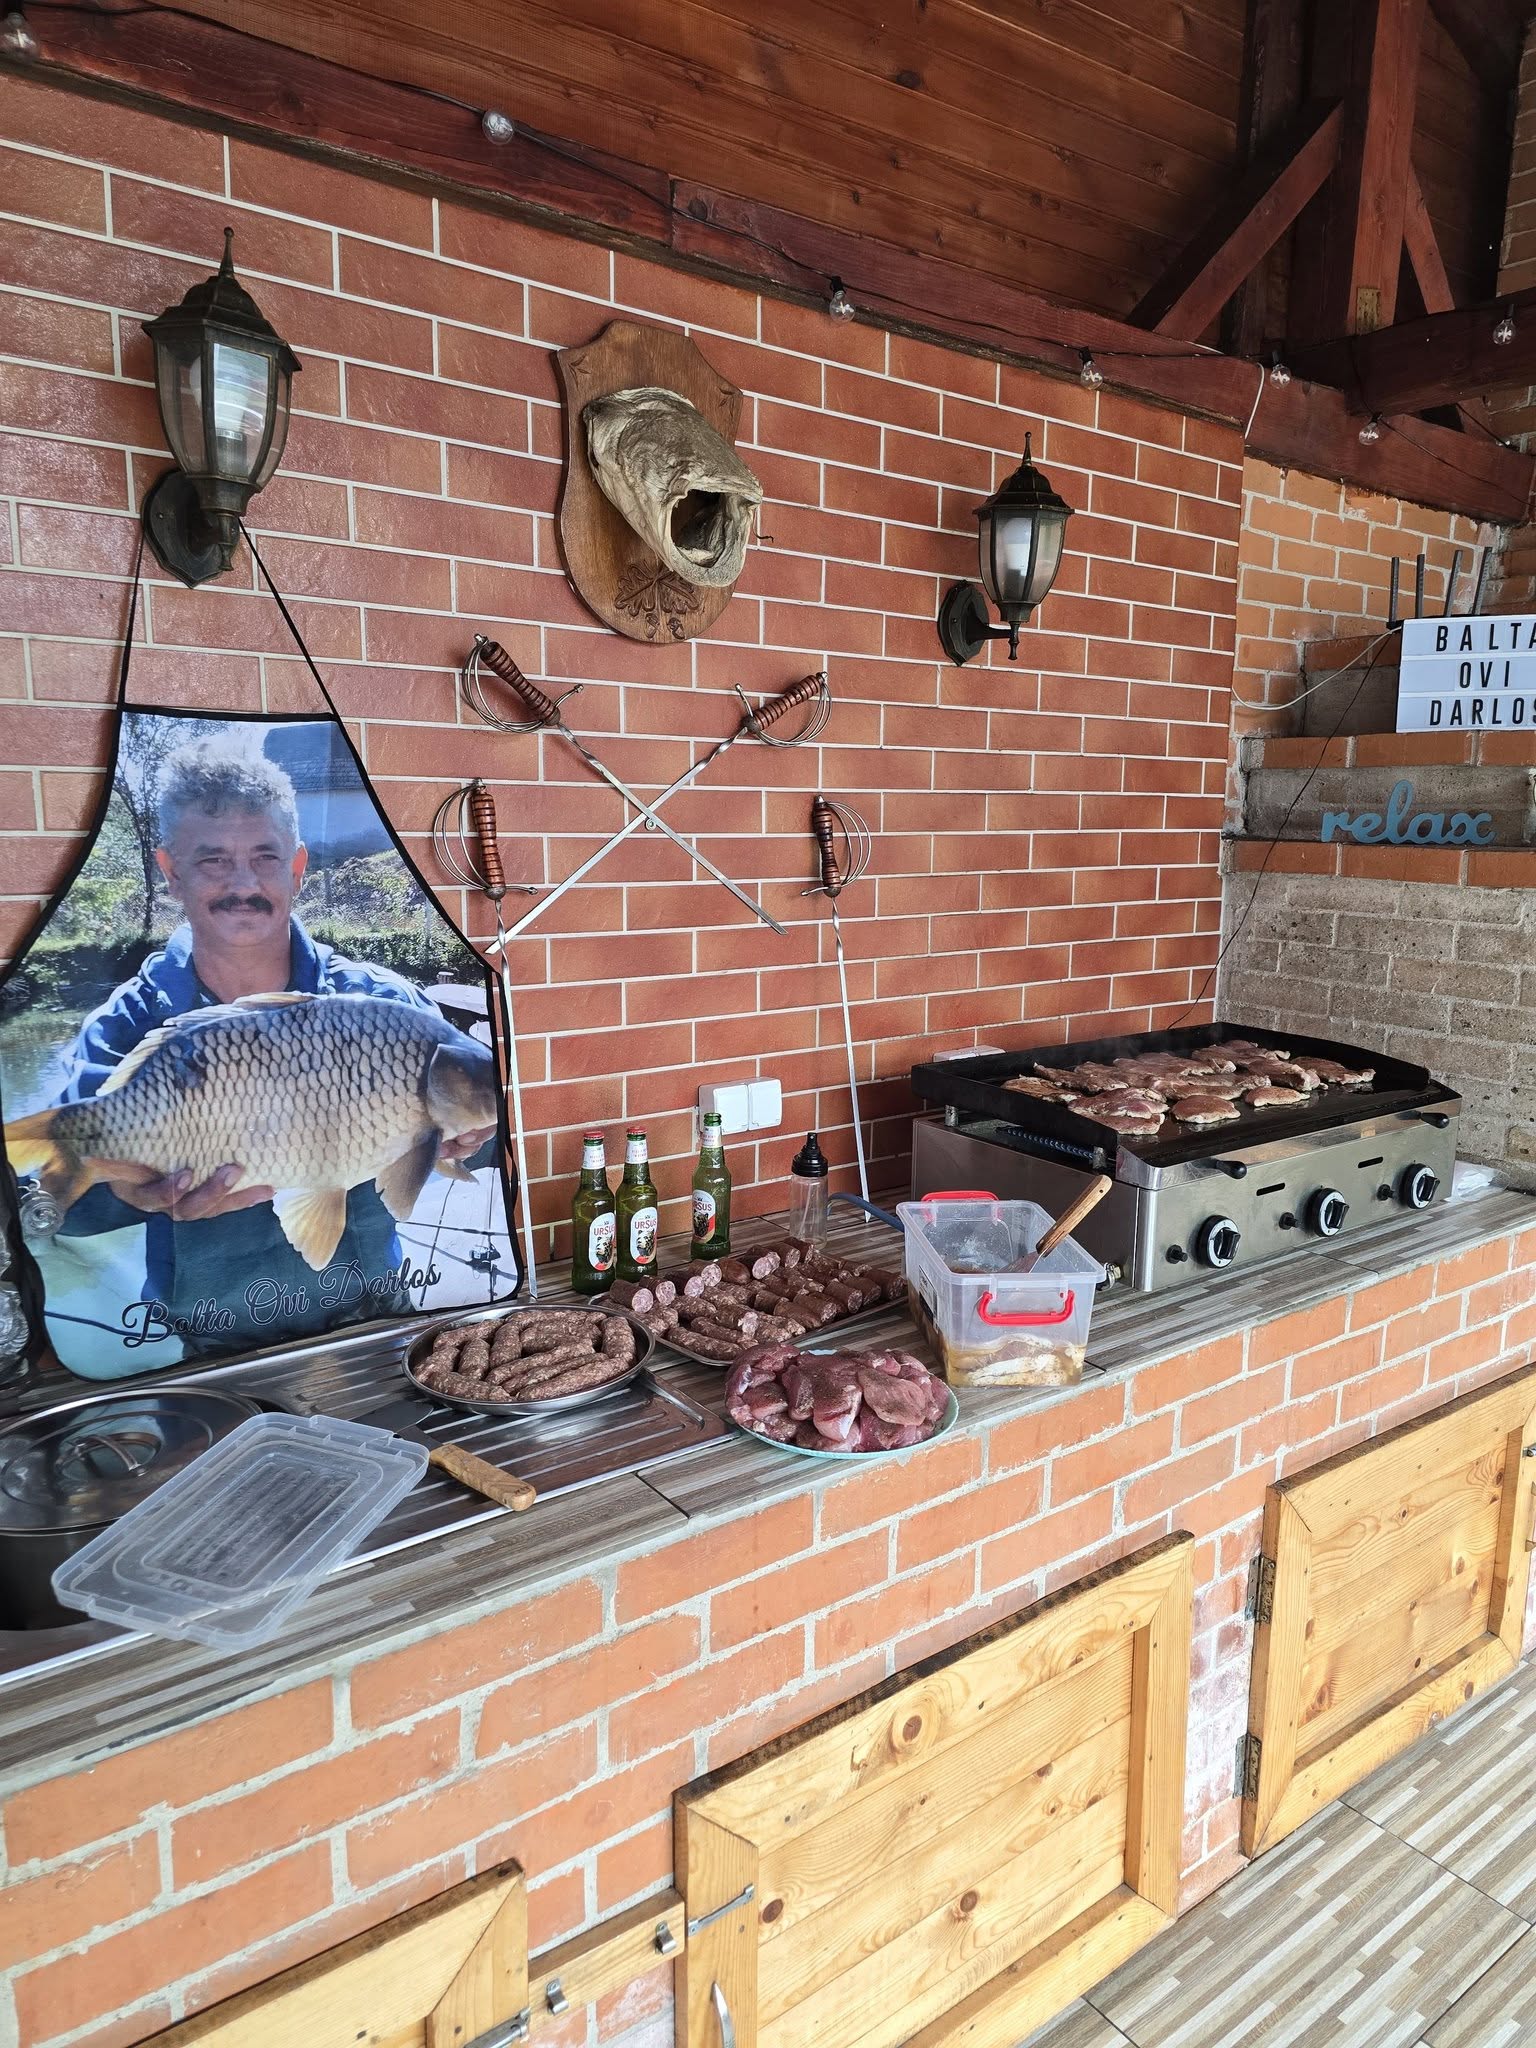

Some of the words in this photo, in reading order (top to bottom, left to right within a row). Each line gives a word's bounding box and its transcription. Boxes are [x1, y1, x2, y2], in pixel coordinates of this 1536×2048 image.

[1436, 622, 1536, 652] BALTA
[1460, 661, 1510, 688] OVI
[1321, 779, 1496, 845] relax
[122, 1297, 237, 1348] Balta
[244, 1277, 310, 1326] Ovi
[318, 1258, 441, 1309] Darlos
